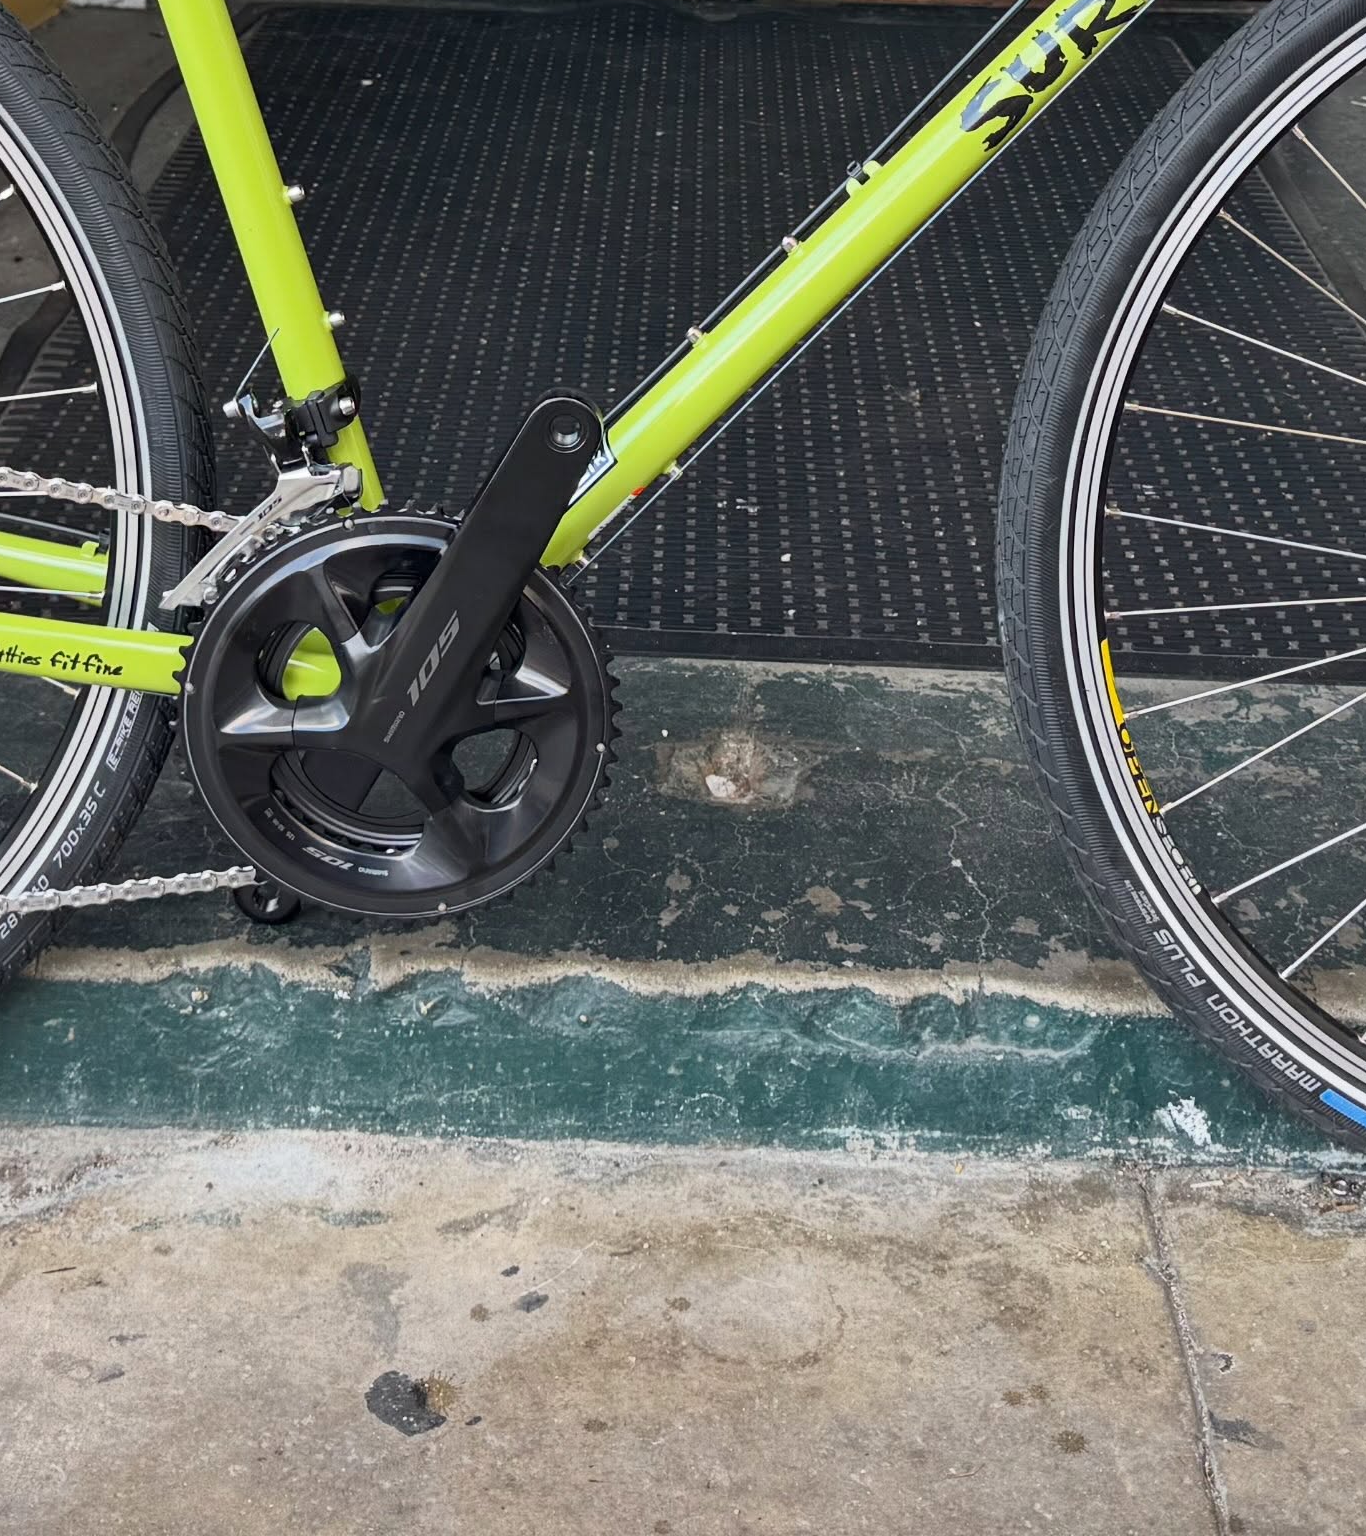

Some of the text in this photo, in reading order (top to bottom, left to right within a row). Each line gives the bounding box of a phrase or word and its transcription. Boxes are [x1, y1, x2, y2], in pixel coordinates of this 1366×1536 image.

[49, 650, 82, 671] fit
[82, 653, 123, 676] fine
[406, 610, 460, 707] 105
[107, 713, 136, 771] E-BIKE
[383, 710, 405, 744] SHIMANO
[302, 845, 354, 870] 105
[1152, 928, 1207, 991] PLUS
[1206, 992, 1322, 1093] MARATHON
